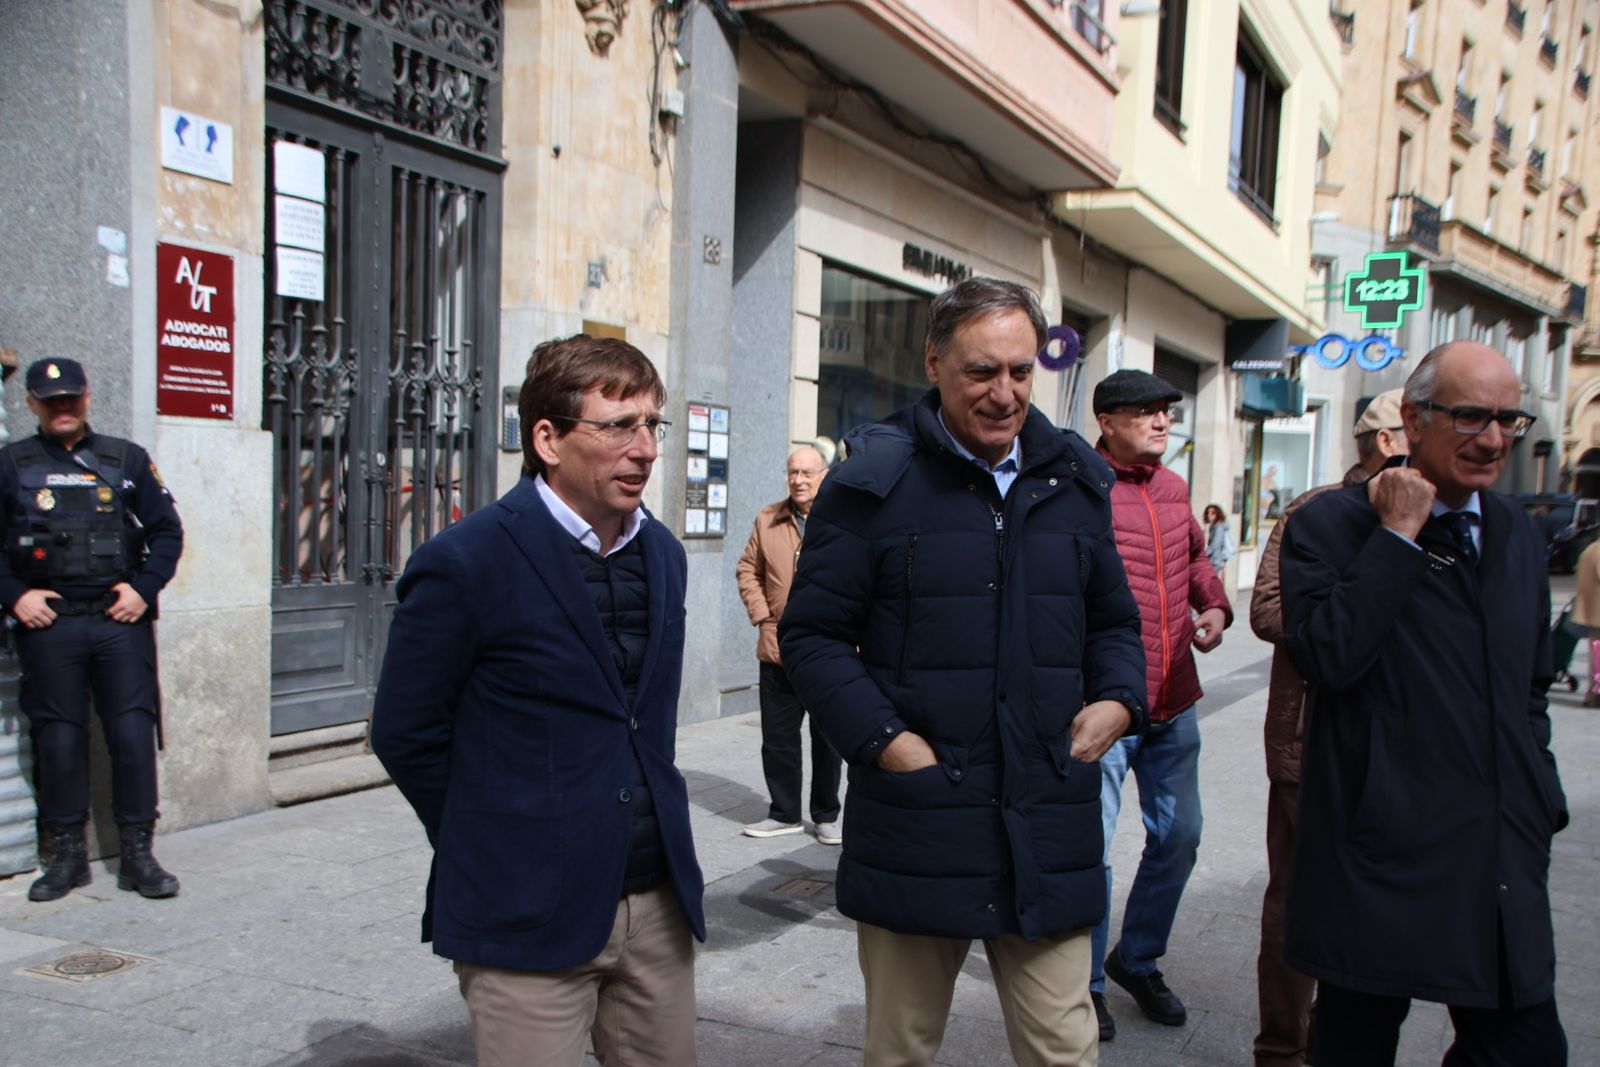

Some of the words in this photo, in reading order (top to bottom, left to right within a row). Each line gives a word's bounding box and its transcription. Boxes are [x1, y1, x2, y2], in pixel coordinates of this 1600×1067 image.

[1356, 279, 1409, 302] 12:23
[164, 319, 228, 339] ADVOCATI
[161, 334, 231, 353] ABOGADOS
